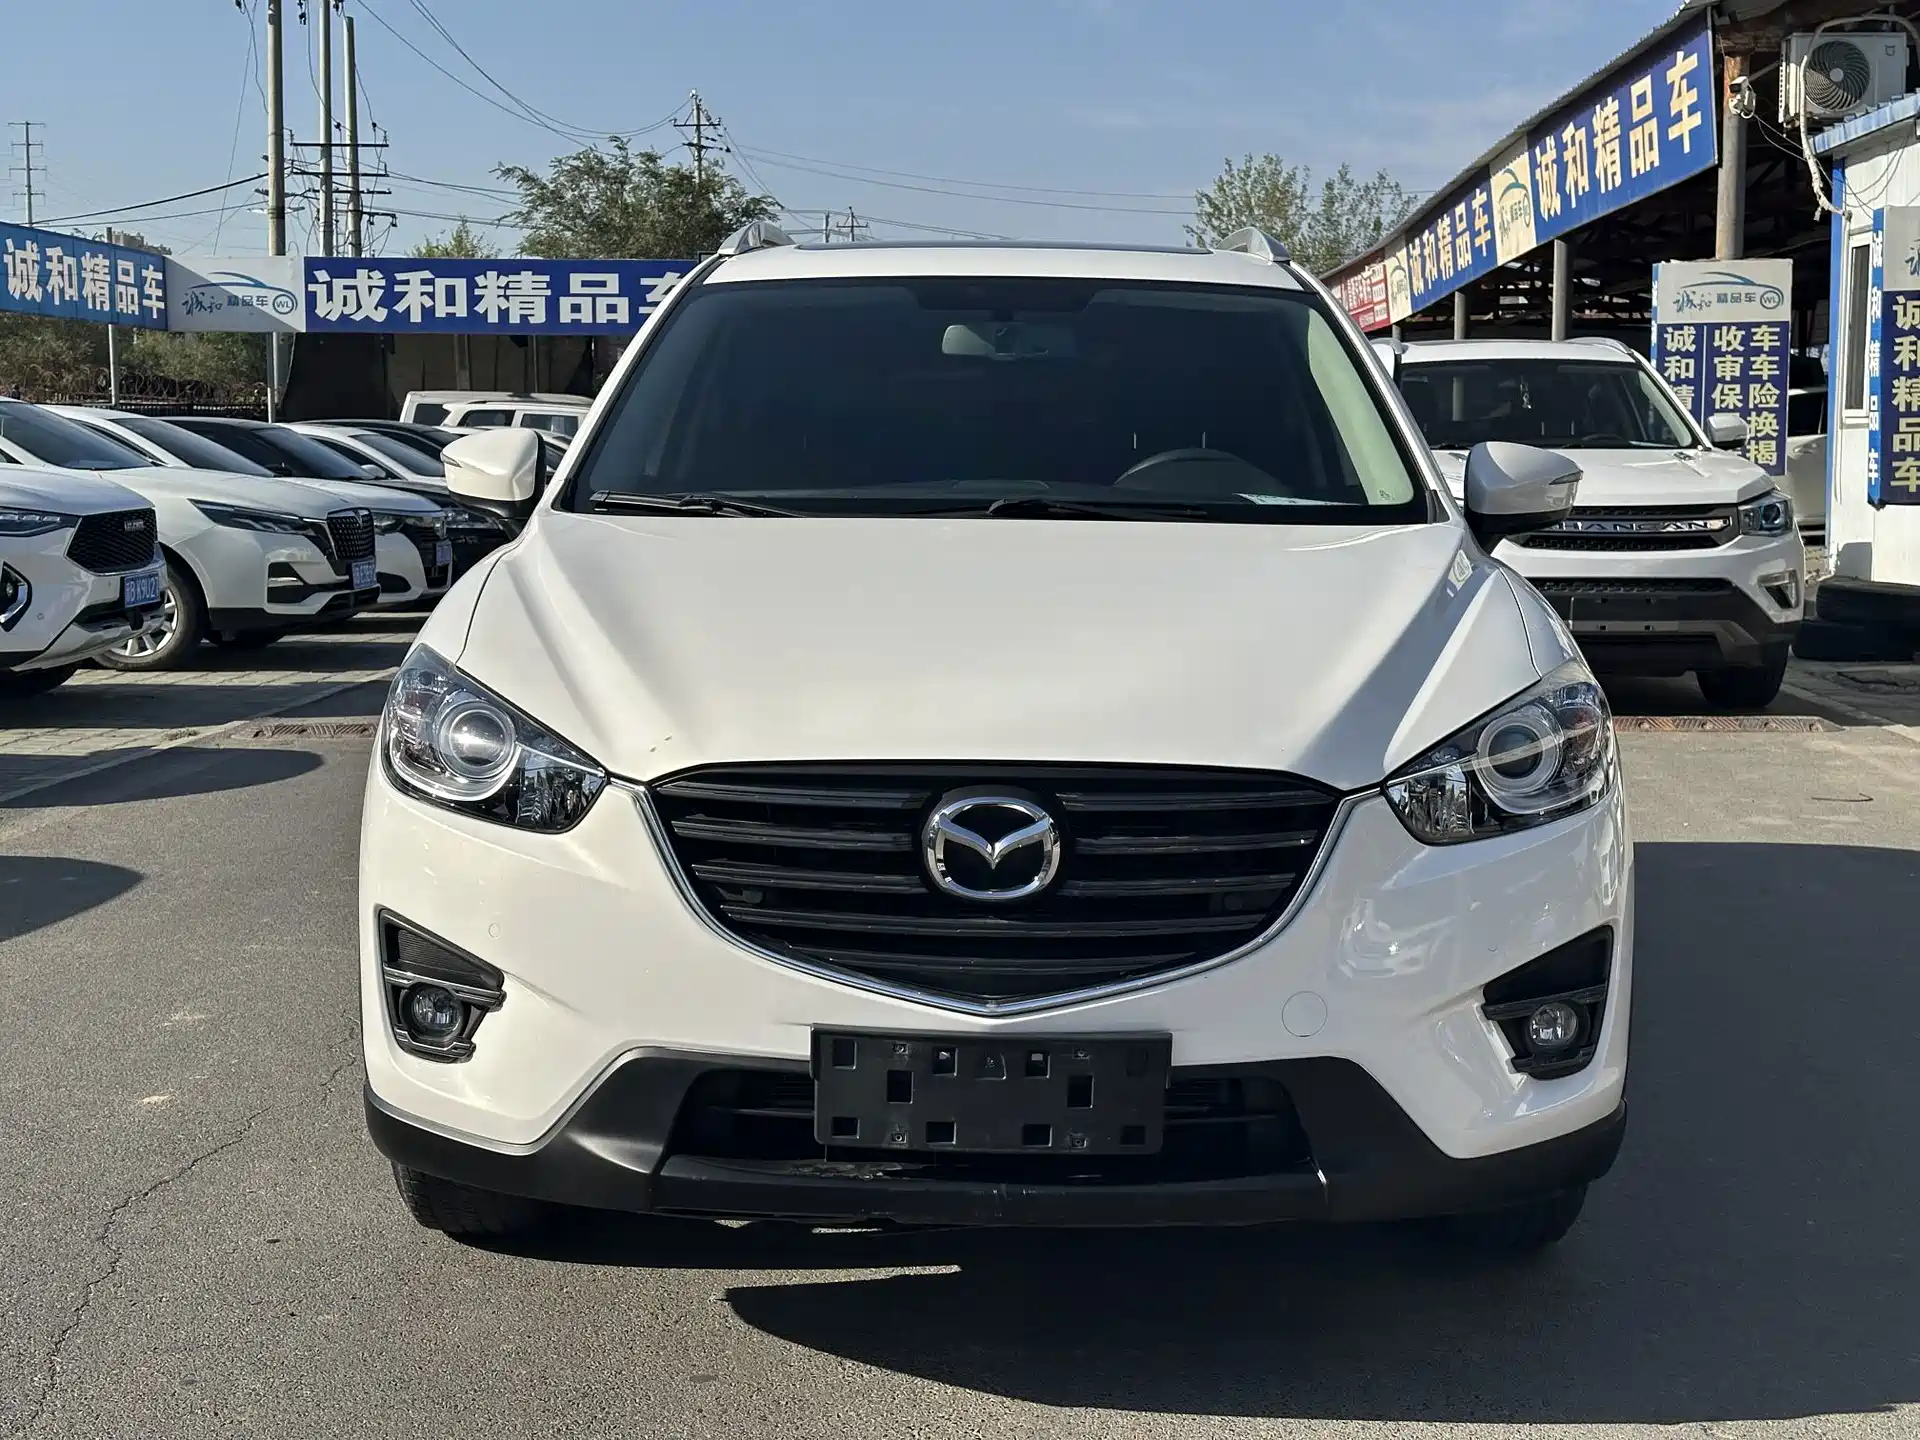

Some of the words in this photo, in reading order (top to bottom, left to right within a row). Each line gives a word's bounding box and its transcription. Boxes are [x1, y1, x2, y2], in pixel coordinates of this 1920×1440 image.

[1535, 51, 1702, 222] 诚和精品车
[1409, 188, 1491, 297] 诚和精品车
[3, 238, 165, 319] 诚和精品车
[1713, 325, 1781, 352] 收车
[1713, 354, 1780, 381] 审车
[1711, 382, 1780, 409] 保险
